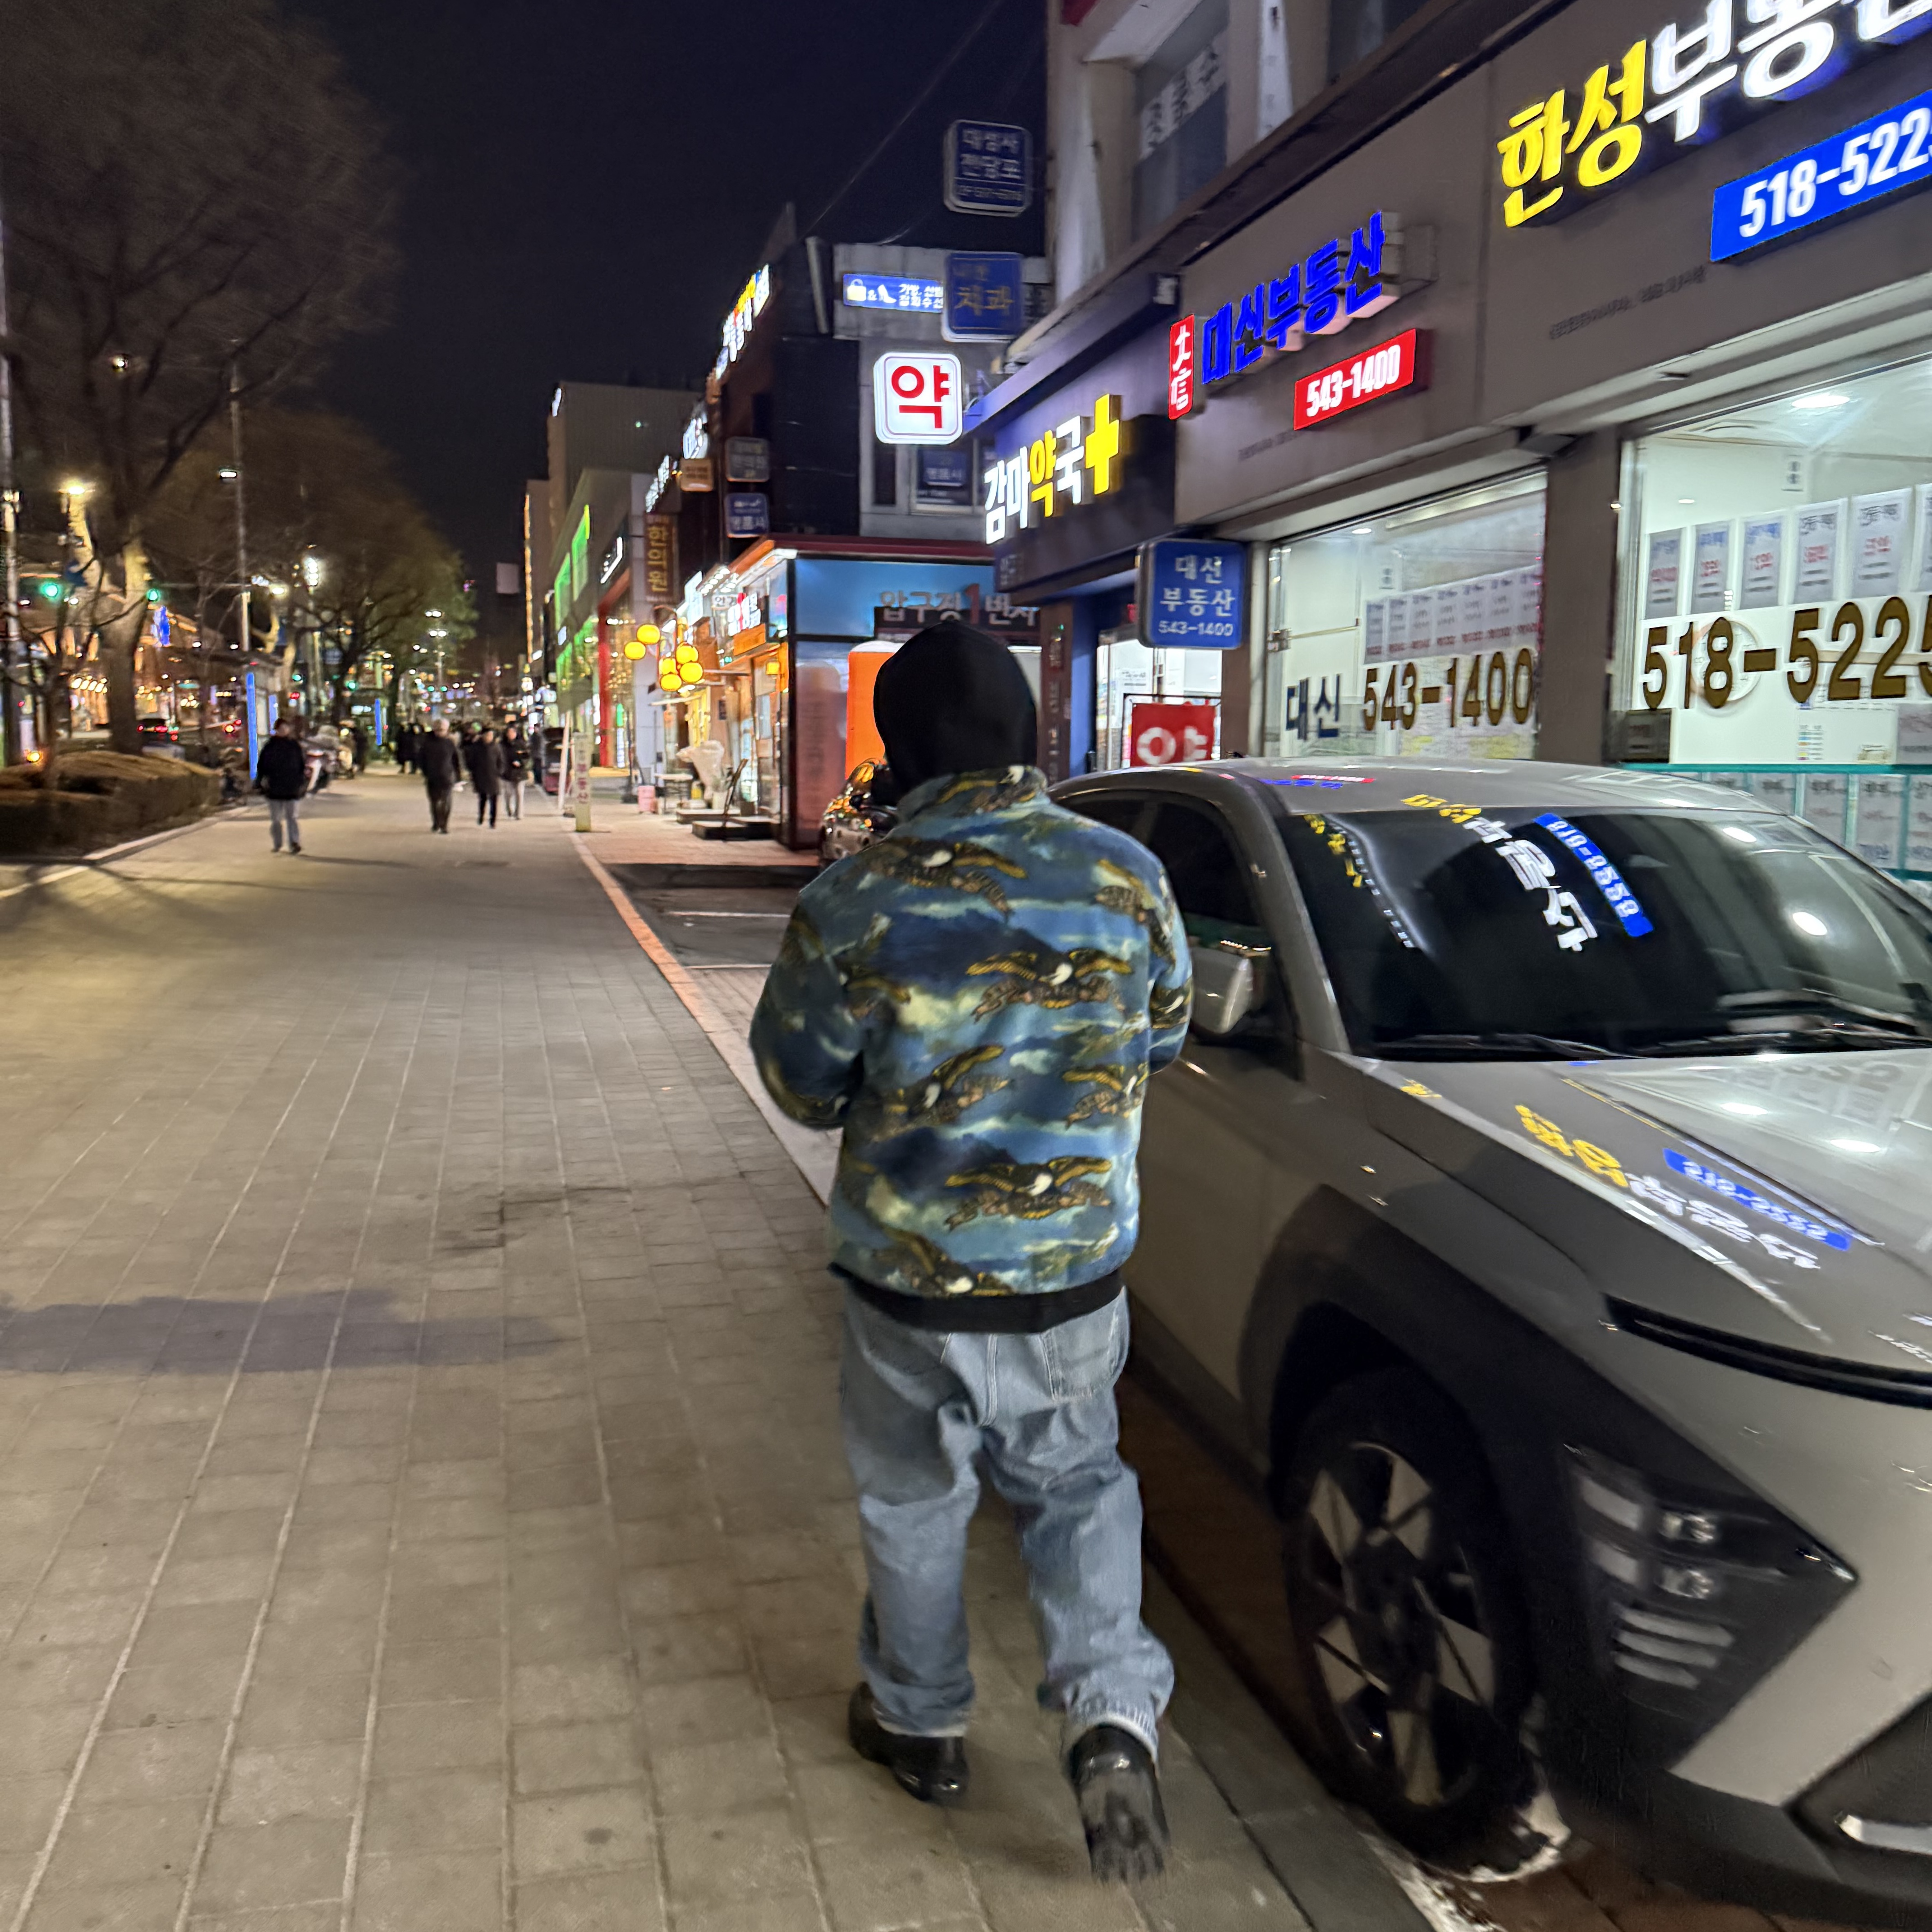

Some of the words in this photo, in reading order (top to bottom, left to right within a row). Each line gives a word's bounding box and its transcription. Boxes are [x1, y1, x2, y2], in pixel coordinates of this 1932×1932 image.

[1739, 107, 1932, 238] 518-522
[954, 285, 1014, 315] 치과
[1202, 211, 1385, 385] 대신부동산
[891, 365, 949, 429] 약
[1306, 344, 1400, 417] 543-1400
[984, 415, 1084, 544] 감마약국
[1160, 588, 1236, 617] 부동산
[1175, 555, 1223, 584] 대신
[1158, 620, 1233, 637] 543-1400
[1286, 673, 1340, 741] 대신
[1362, 648, 1533, 731] 543-1400
